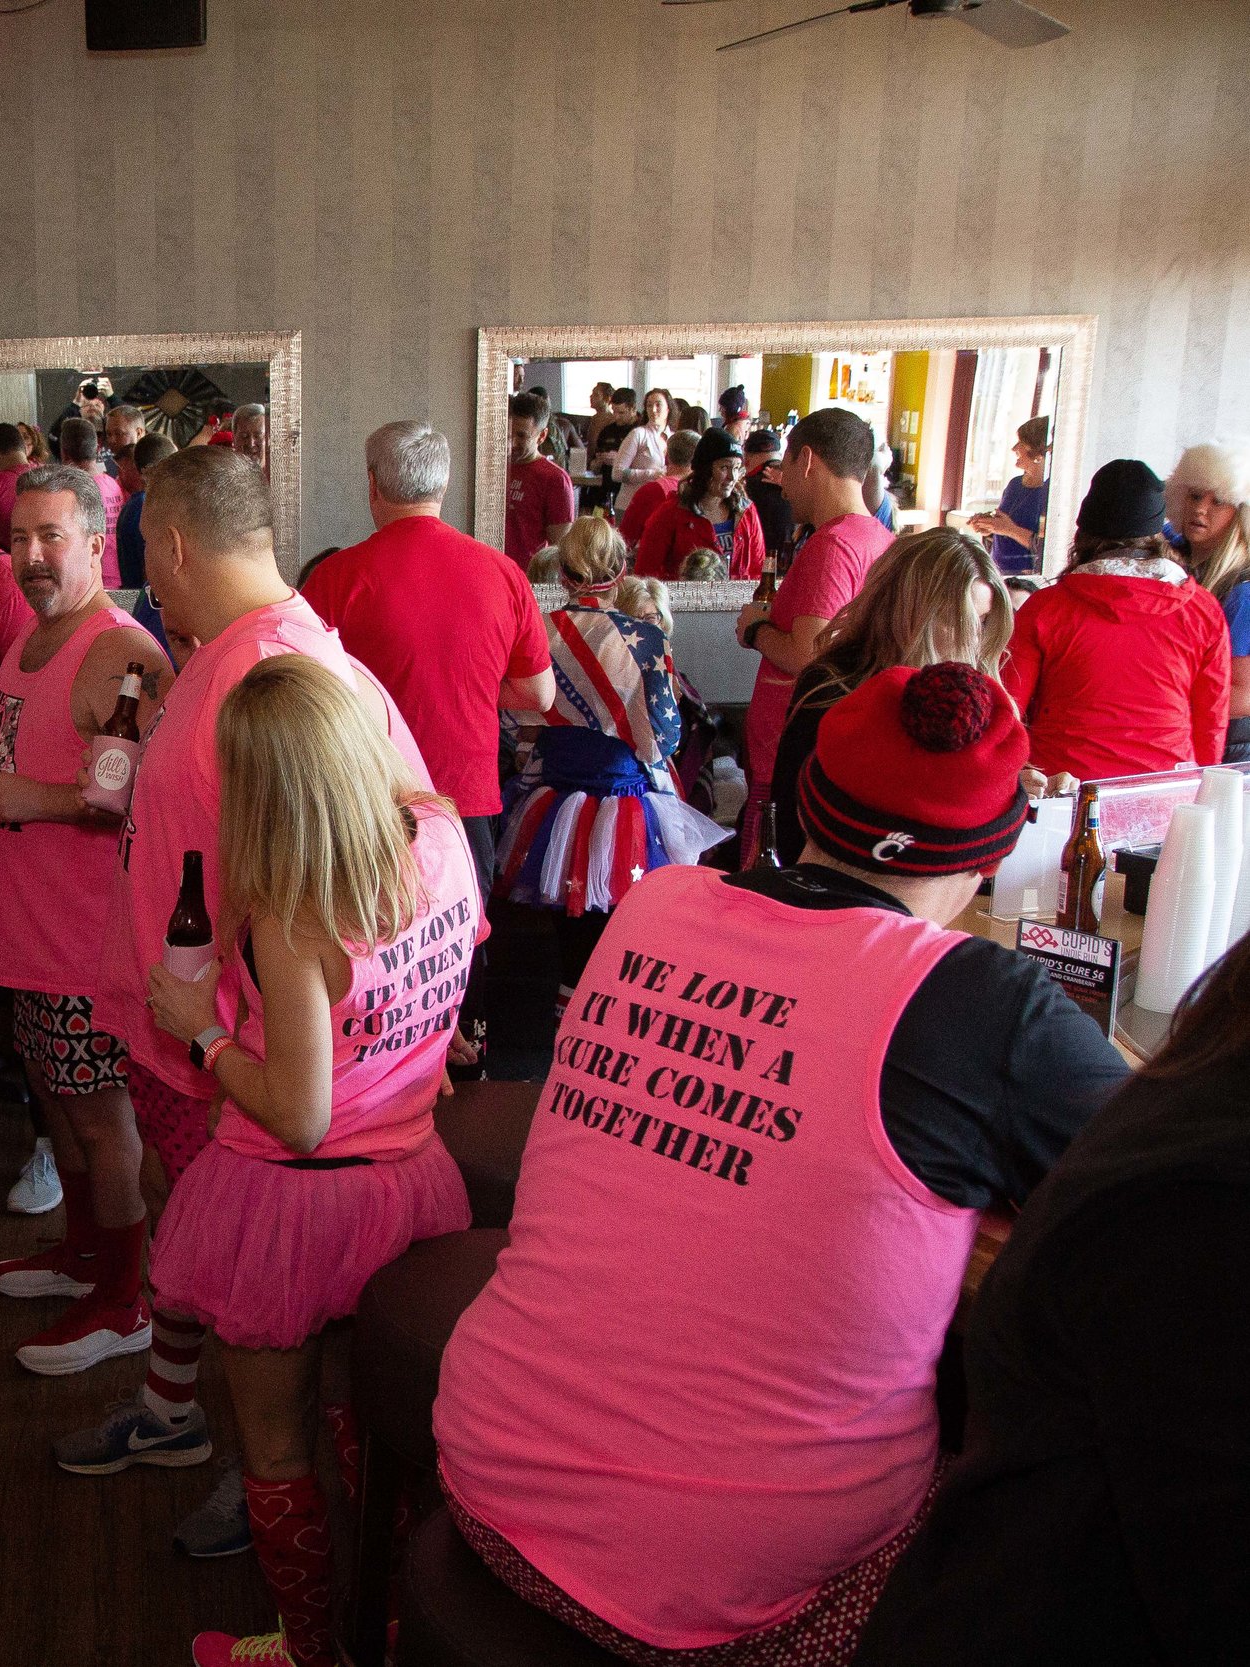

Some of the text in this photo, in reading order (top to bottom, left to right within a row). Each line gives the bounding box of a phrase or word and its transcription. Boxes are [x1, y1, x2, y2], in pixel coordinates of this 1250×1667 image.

[97, 753, 127, 777] Jill's
[105, 772, 124, 782] WISH
[379, 897, 470, 974] WE LOVE
[1060, 946, 1098, 965] UNDIE RUN
[1061, 930, 1112, 957] CUPID'S
[364, 982, 395, 1011] IT
[402, 937, 463, 993] WHEN
[421, 965, 469, 1012] COM
[618, 949, 798, 1028] WE LOVE
[1051, 971, 1096, 988] AND CRANBERRY
[1064, 963, 1091, 976] CURE
[1091, 969, 1105, 980] $6
[352, 1004, 461, 1063] TOGETH
[580, 991, 795, 1086] IT WHEN A
[556, 1035, 803, 1143] CURE COMES
[549, 1081, 754, 1187] TOGETHER
